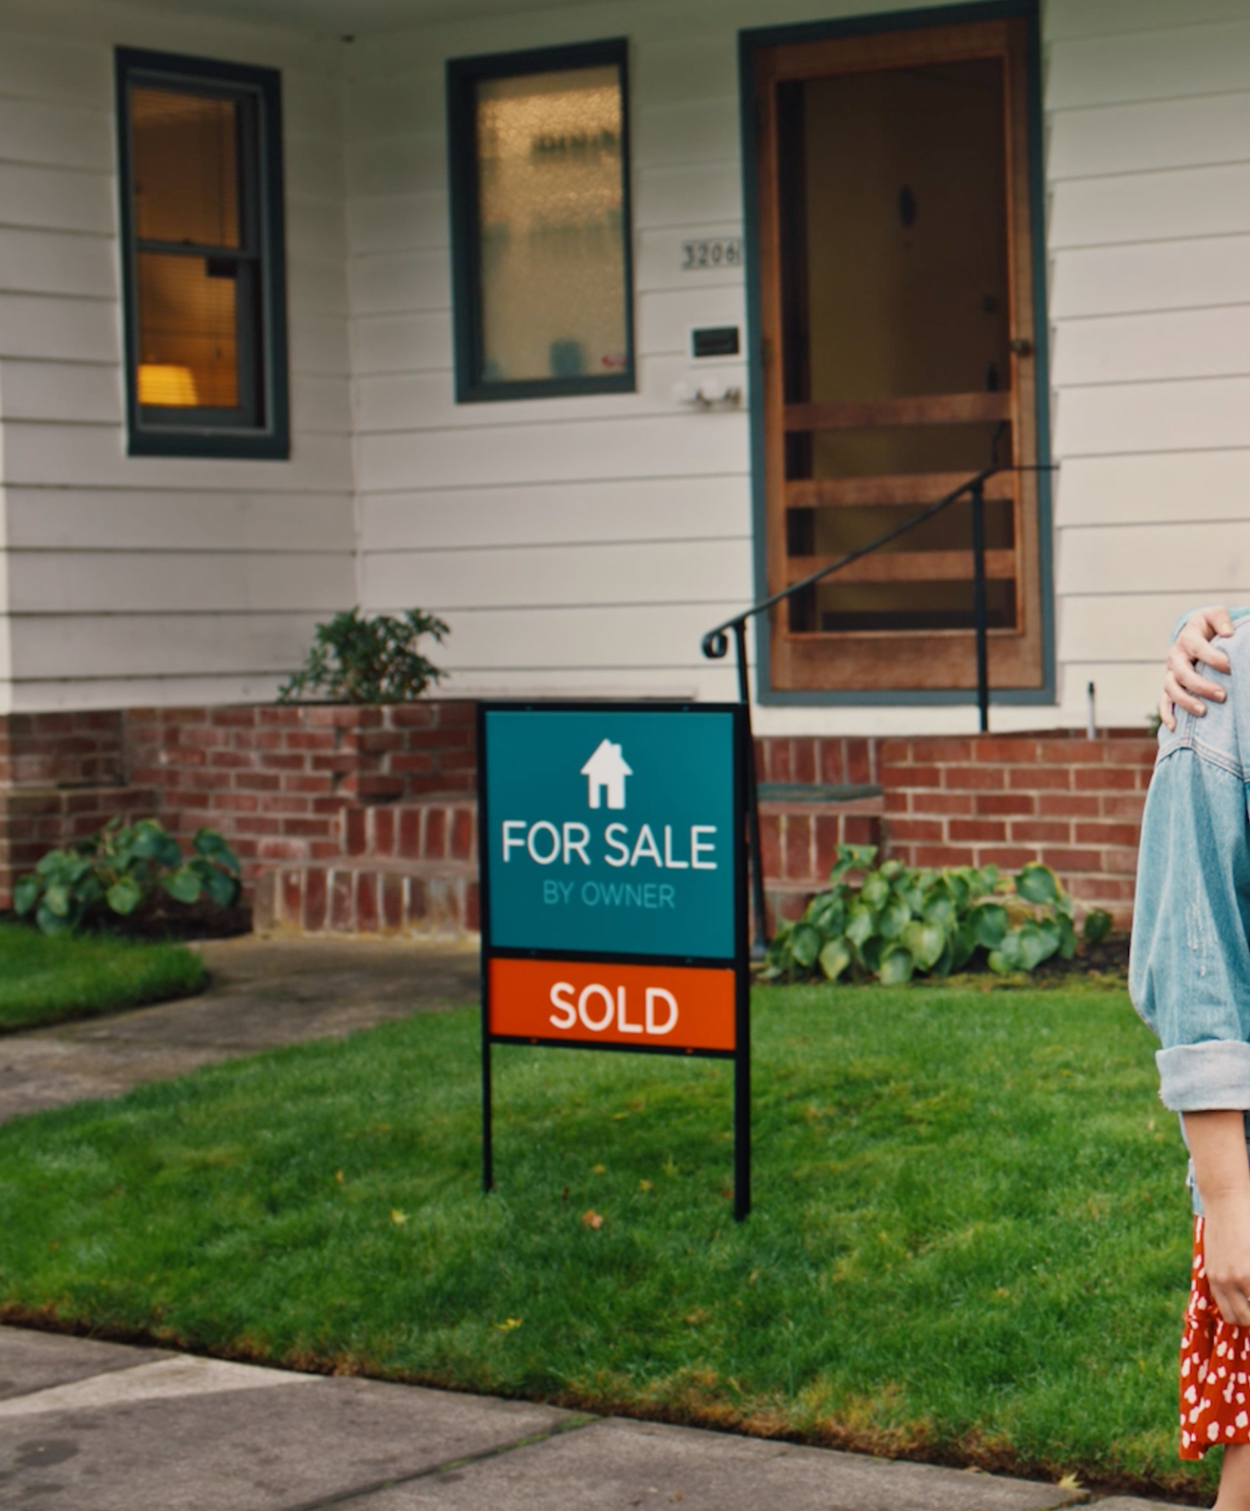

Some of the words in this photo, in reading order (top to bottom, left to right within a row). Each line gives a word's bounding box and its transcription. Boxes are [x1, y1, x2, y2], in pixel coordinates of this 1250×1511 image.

[683, 242, 736, 268] 3206
[502, 820, 591, 865] FOR
[604, 823, 717, 869] SALE
[543, 880, 574, 904] BY
[582, 882, 675, 908] OWNER
[549, 982, 679, 1035] SOLD
